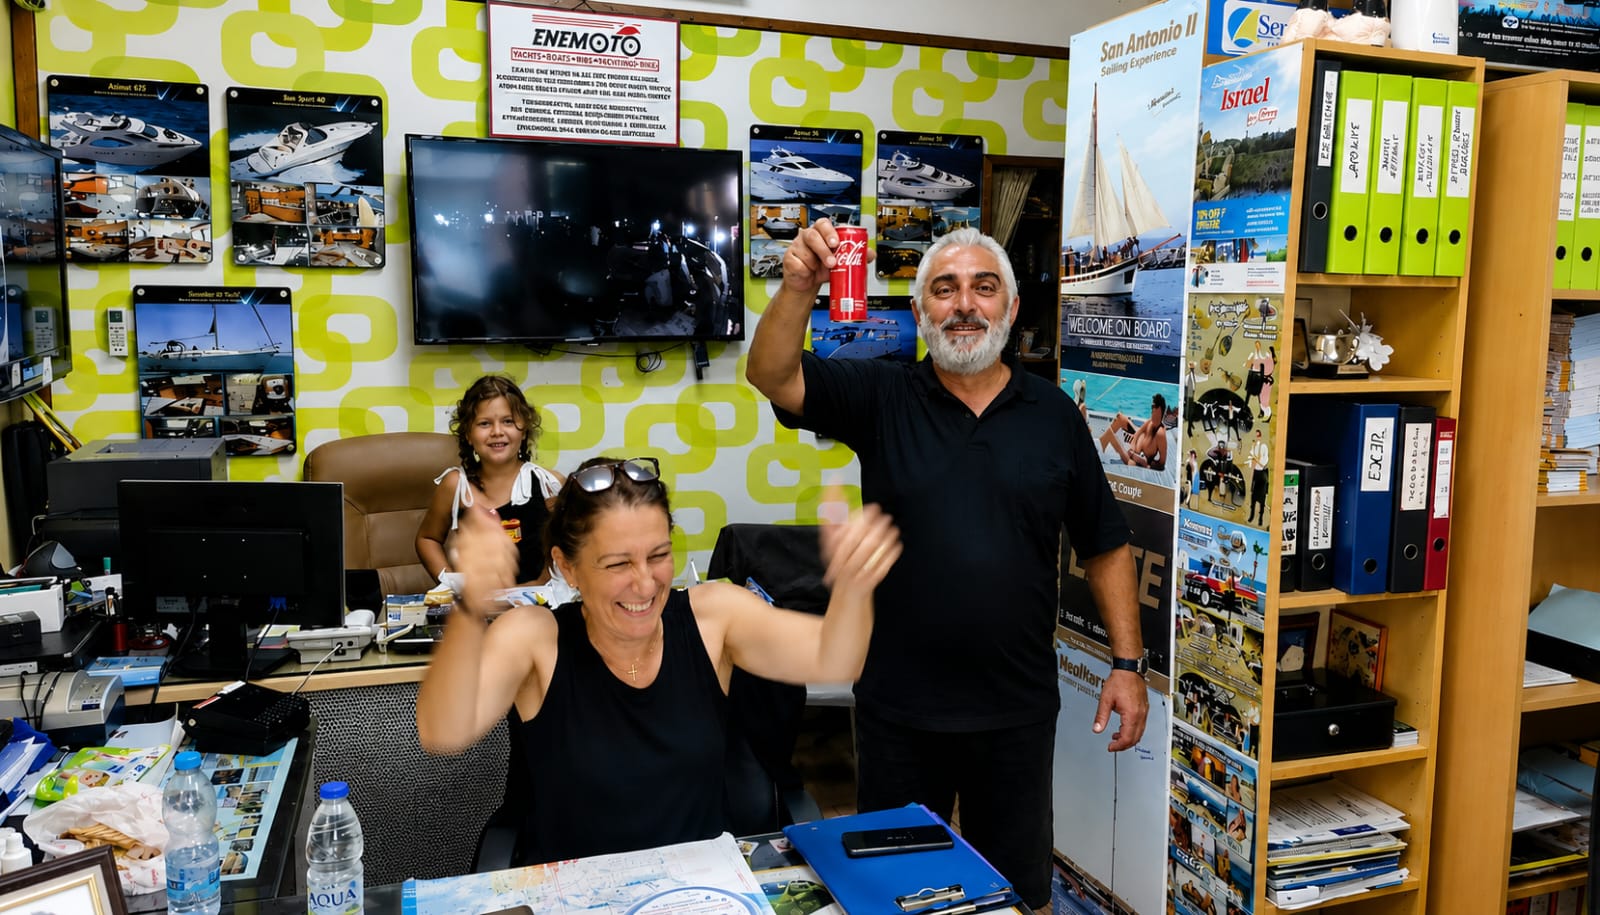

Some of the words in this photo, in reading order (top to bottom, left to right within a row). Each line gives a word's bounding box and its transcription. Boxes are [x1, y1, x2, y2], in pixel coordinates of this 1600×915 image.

[532, 28, 641, 57] ENEMOTO
[1100, 41, 1124, 63] San
[1125, 19, 1183, 55] Antonio
[1185, 12, 1198, 37] II
[513, 50, 541, 60] YACHTS
[1101, 61, 1129, 77] Sailing
[1130, 47, 1177, 69] Experience
[1220, 77, 1270, 111] Israel
[1069, 316, 1114, 335] WELCOME
[1115, 319, 1131, 336] ON
[1134, 321, 1171, 339] BOARD
[1118, 482, 1142, 499] Coupe
[309, 888, 356, 910] AQUA
